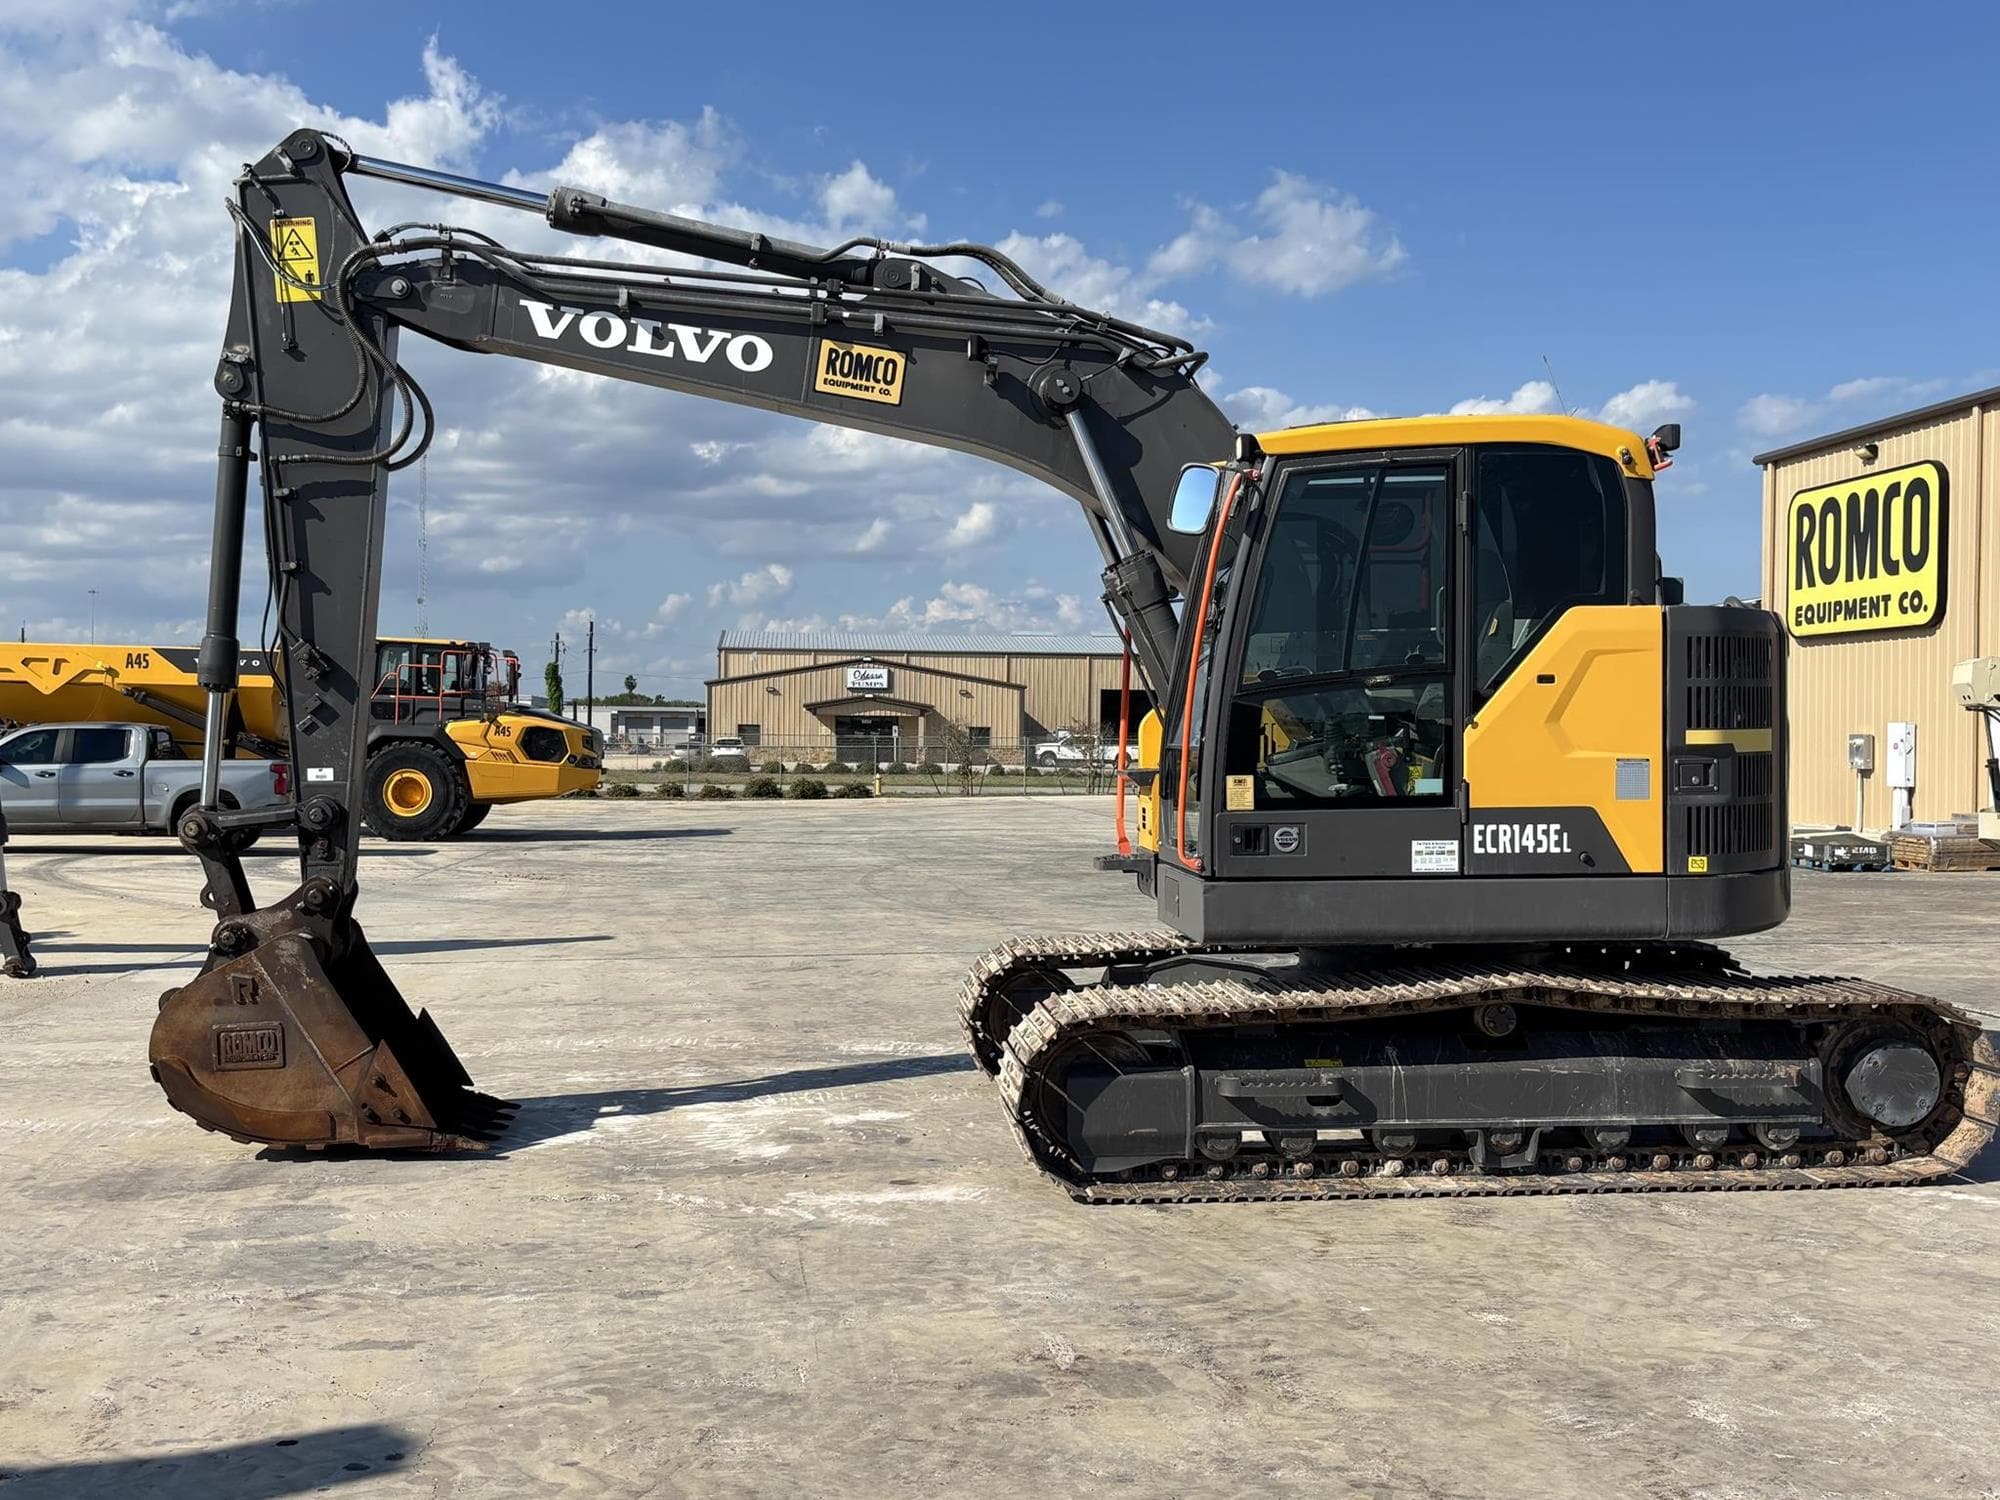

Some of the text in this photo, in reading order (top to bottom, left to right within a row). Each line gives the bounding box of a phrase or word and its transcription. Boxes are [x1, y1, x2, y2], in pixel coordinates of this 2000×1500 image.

[519, 299, 774, 372] VOLVO
[825, 347, 898, 386] ROMCO
[823, 377, 876, 393] EQUIPMENT
[878, 387, 892, 396] CO.
[1795, 477, 1930, 591] ROMCO
[1795, 590, 1928, 627] EQUIPMENT CO.
[125, 653, 149, 669] A45
[494, 725, 512, 737] A45
